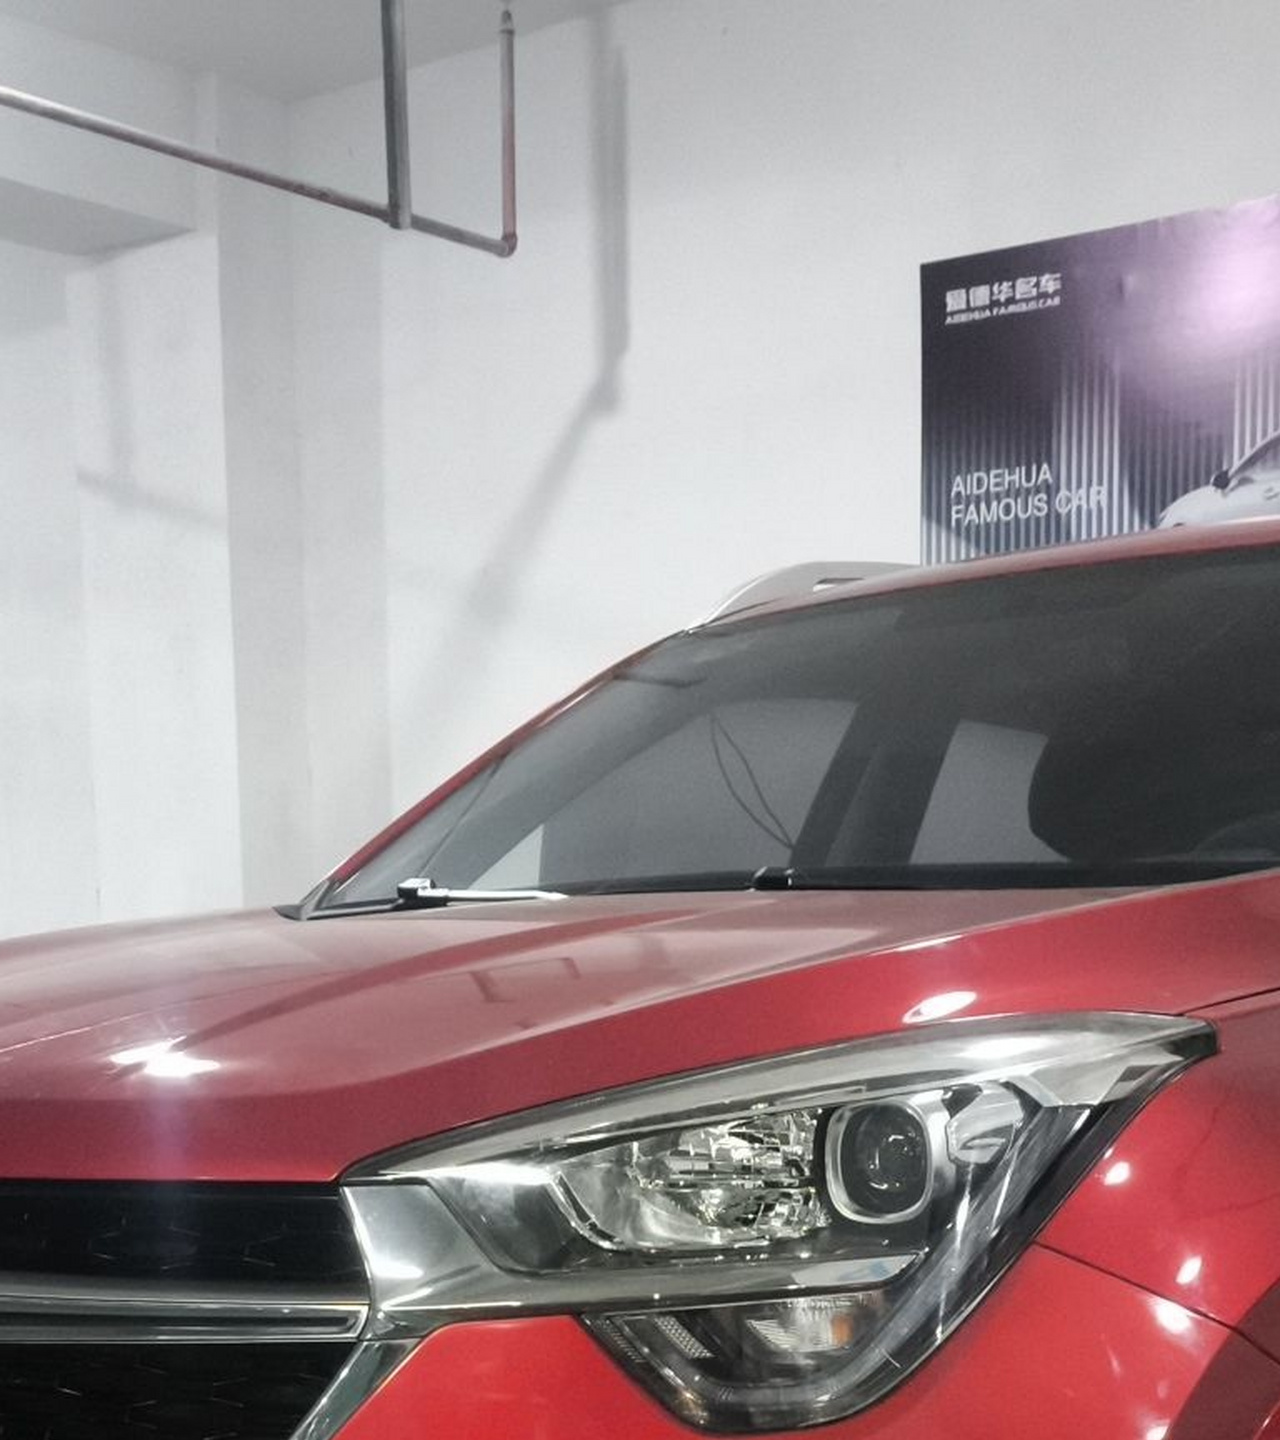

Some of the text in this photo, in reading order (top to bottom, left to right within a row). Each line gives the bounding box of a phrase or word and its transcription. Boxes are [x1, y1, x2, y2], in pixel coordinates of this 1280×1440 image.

[951, 462, 1053, 500] AIDEHUA
[951, 485, 1108, 529] FAMOUS CAR
